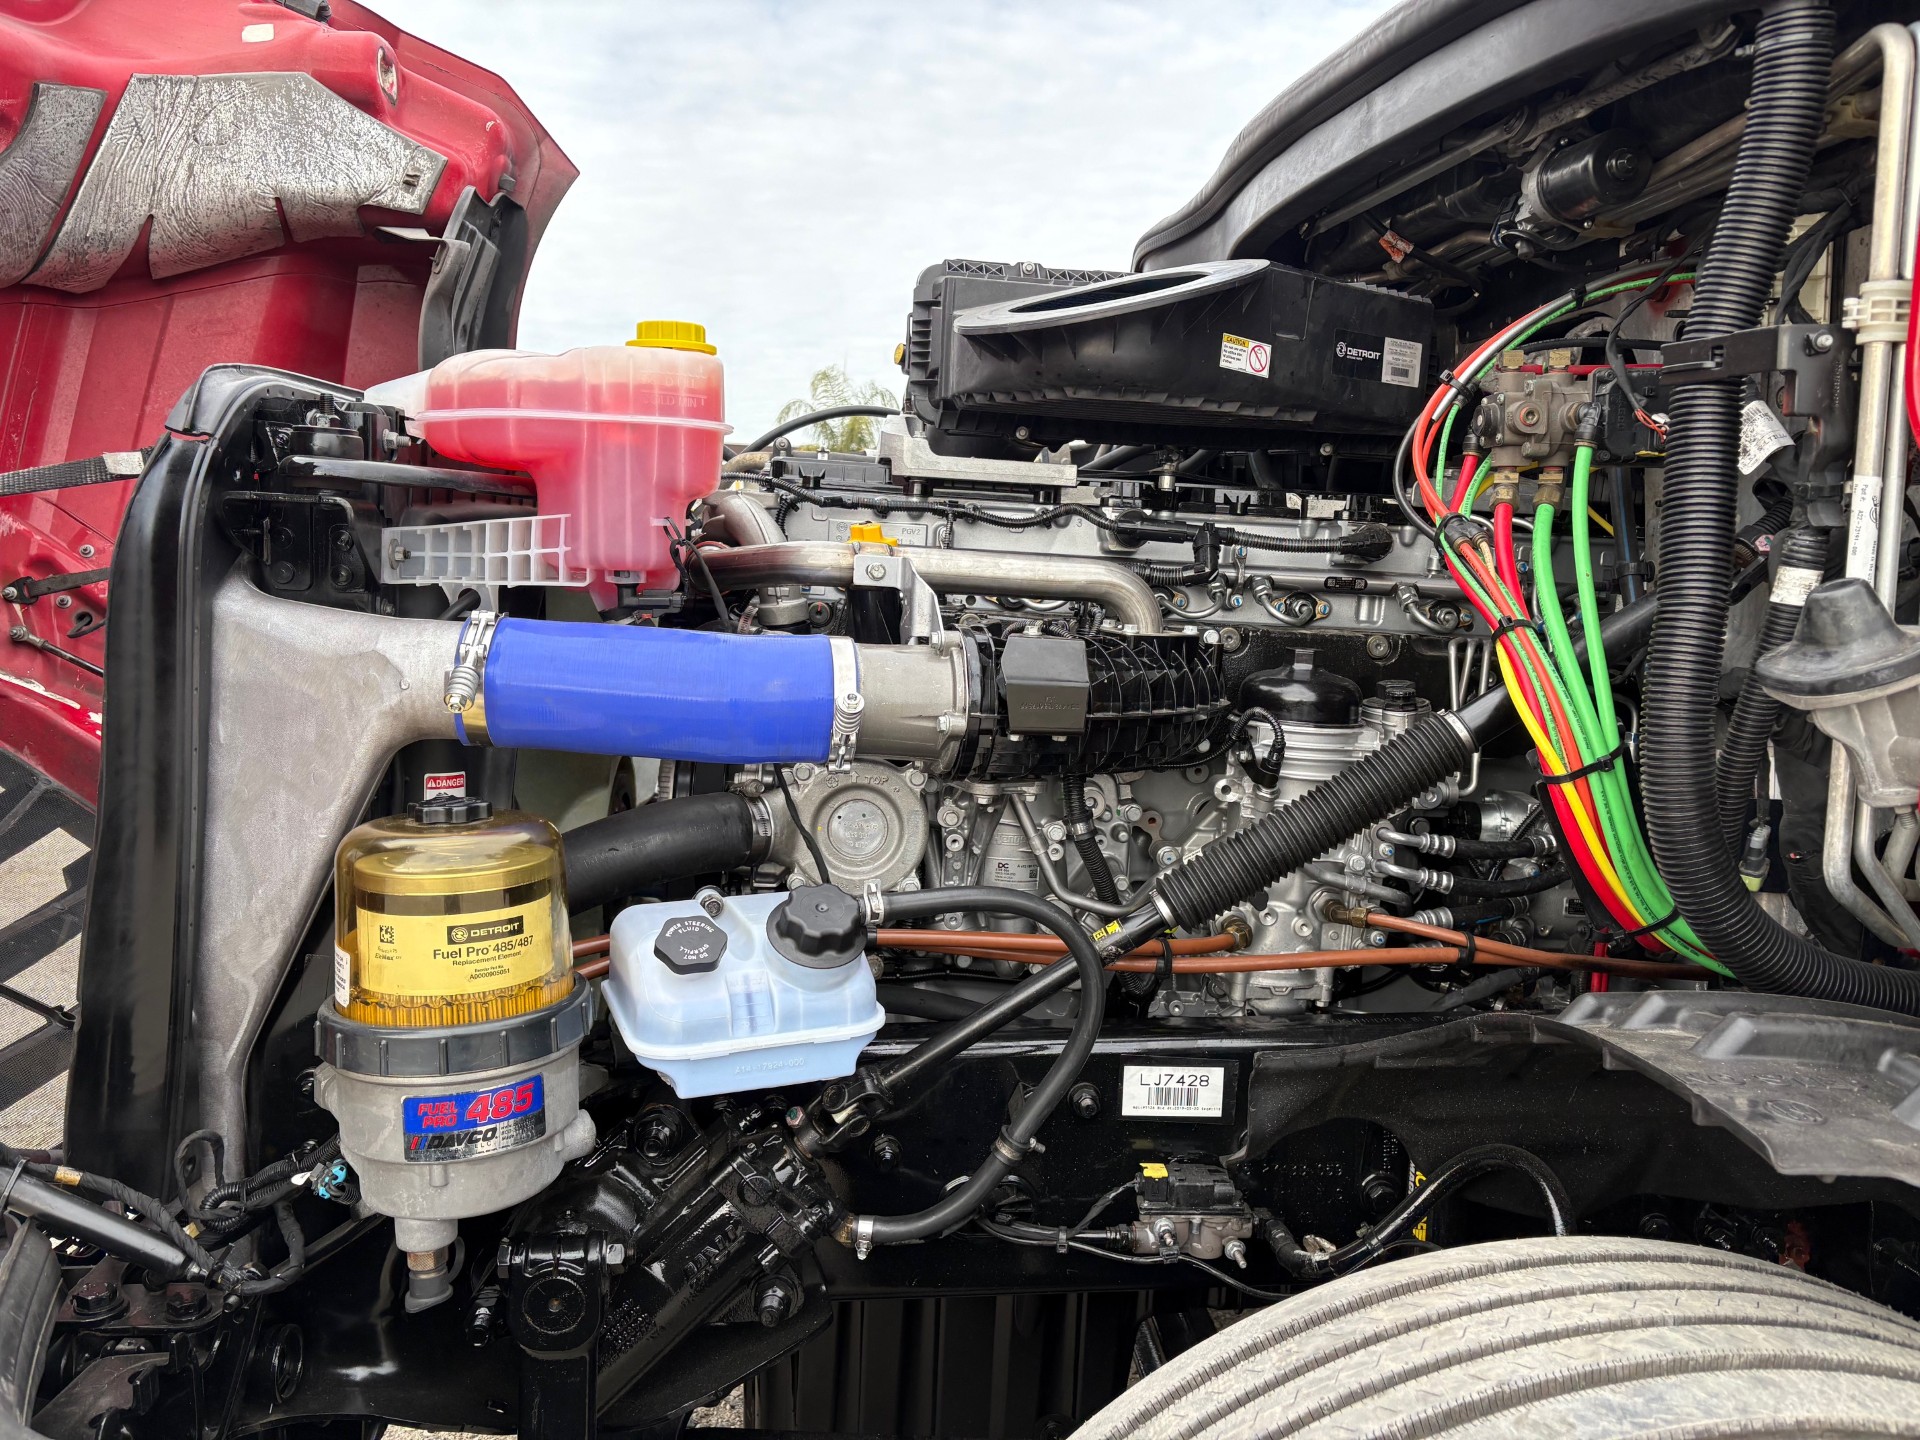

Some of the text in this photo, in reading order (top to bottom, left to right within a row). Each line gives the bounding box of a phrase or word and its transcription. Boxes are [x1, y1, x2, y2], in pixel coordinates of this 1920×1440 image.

[1226, 336, 1246, 347] CAUTION
[1346, 347, 1382, 360] DETROIT
[901, 527, 921, 536] PGV2
[436, 777, 464, 787] DANGER
[864, 776, 889, 785] TOP
[470, 922, 521, 938] DETROIT
[665, 920, 715, 938] POWER STEERING
[677, 926, 700, 934] FLUID
[433, 947, 462, 960] Fuel
[493, 935, 534, 953] 485/487
[679, 943, 710, 954] OVERFILL
[452, 950, 522, 967] Replacement Element
[1139, 1073, 1210, 1088] LJ7428
[418, 1082, 535, 1124] FUEL 485
[422, 1113, 458, 1129] PRO
[427, 1126, 498, 1150] DAVCO
